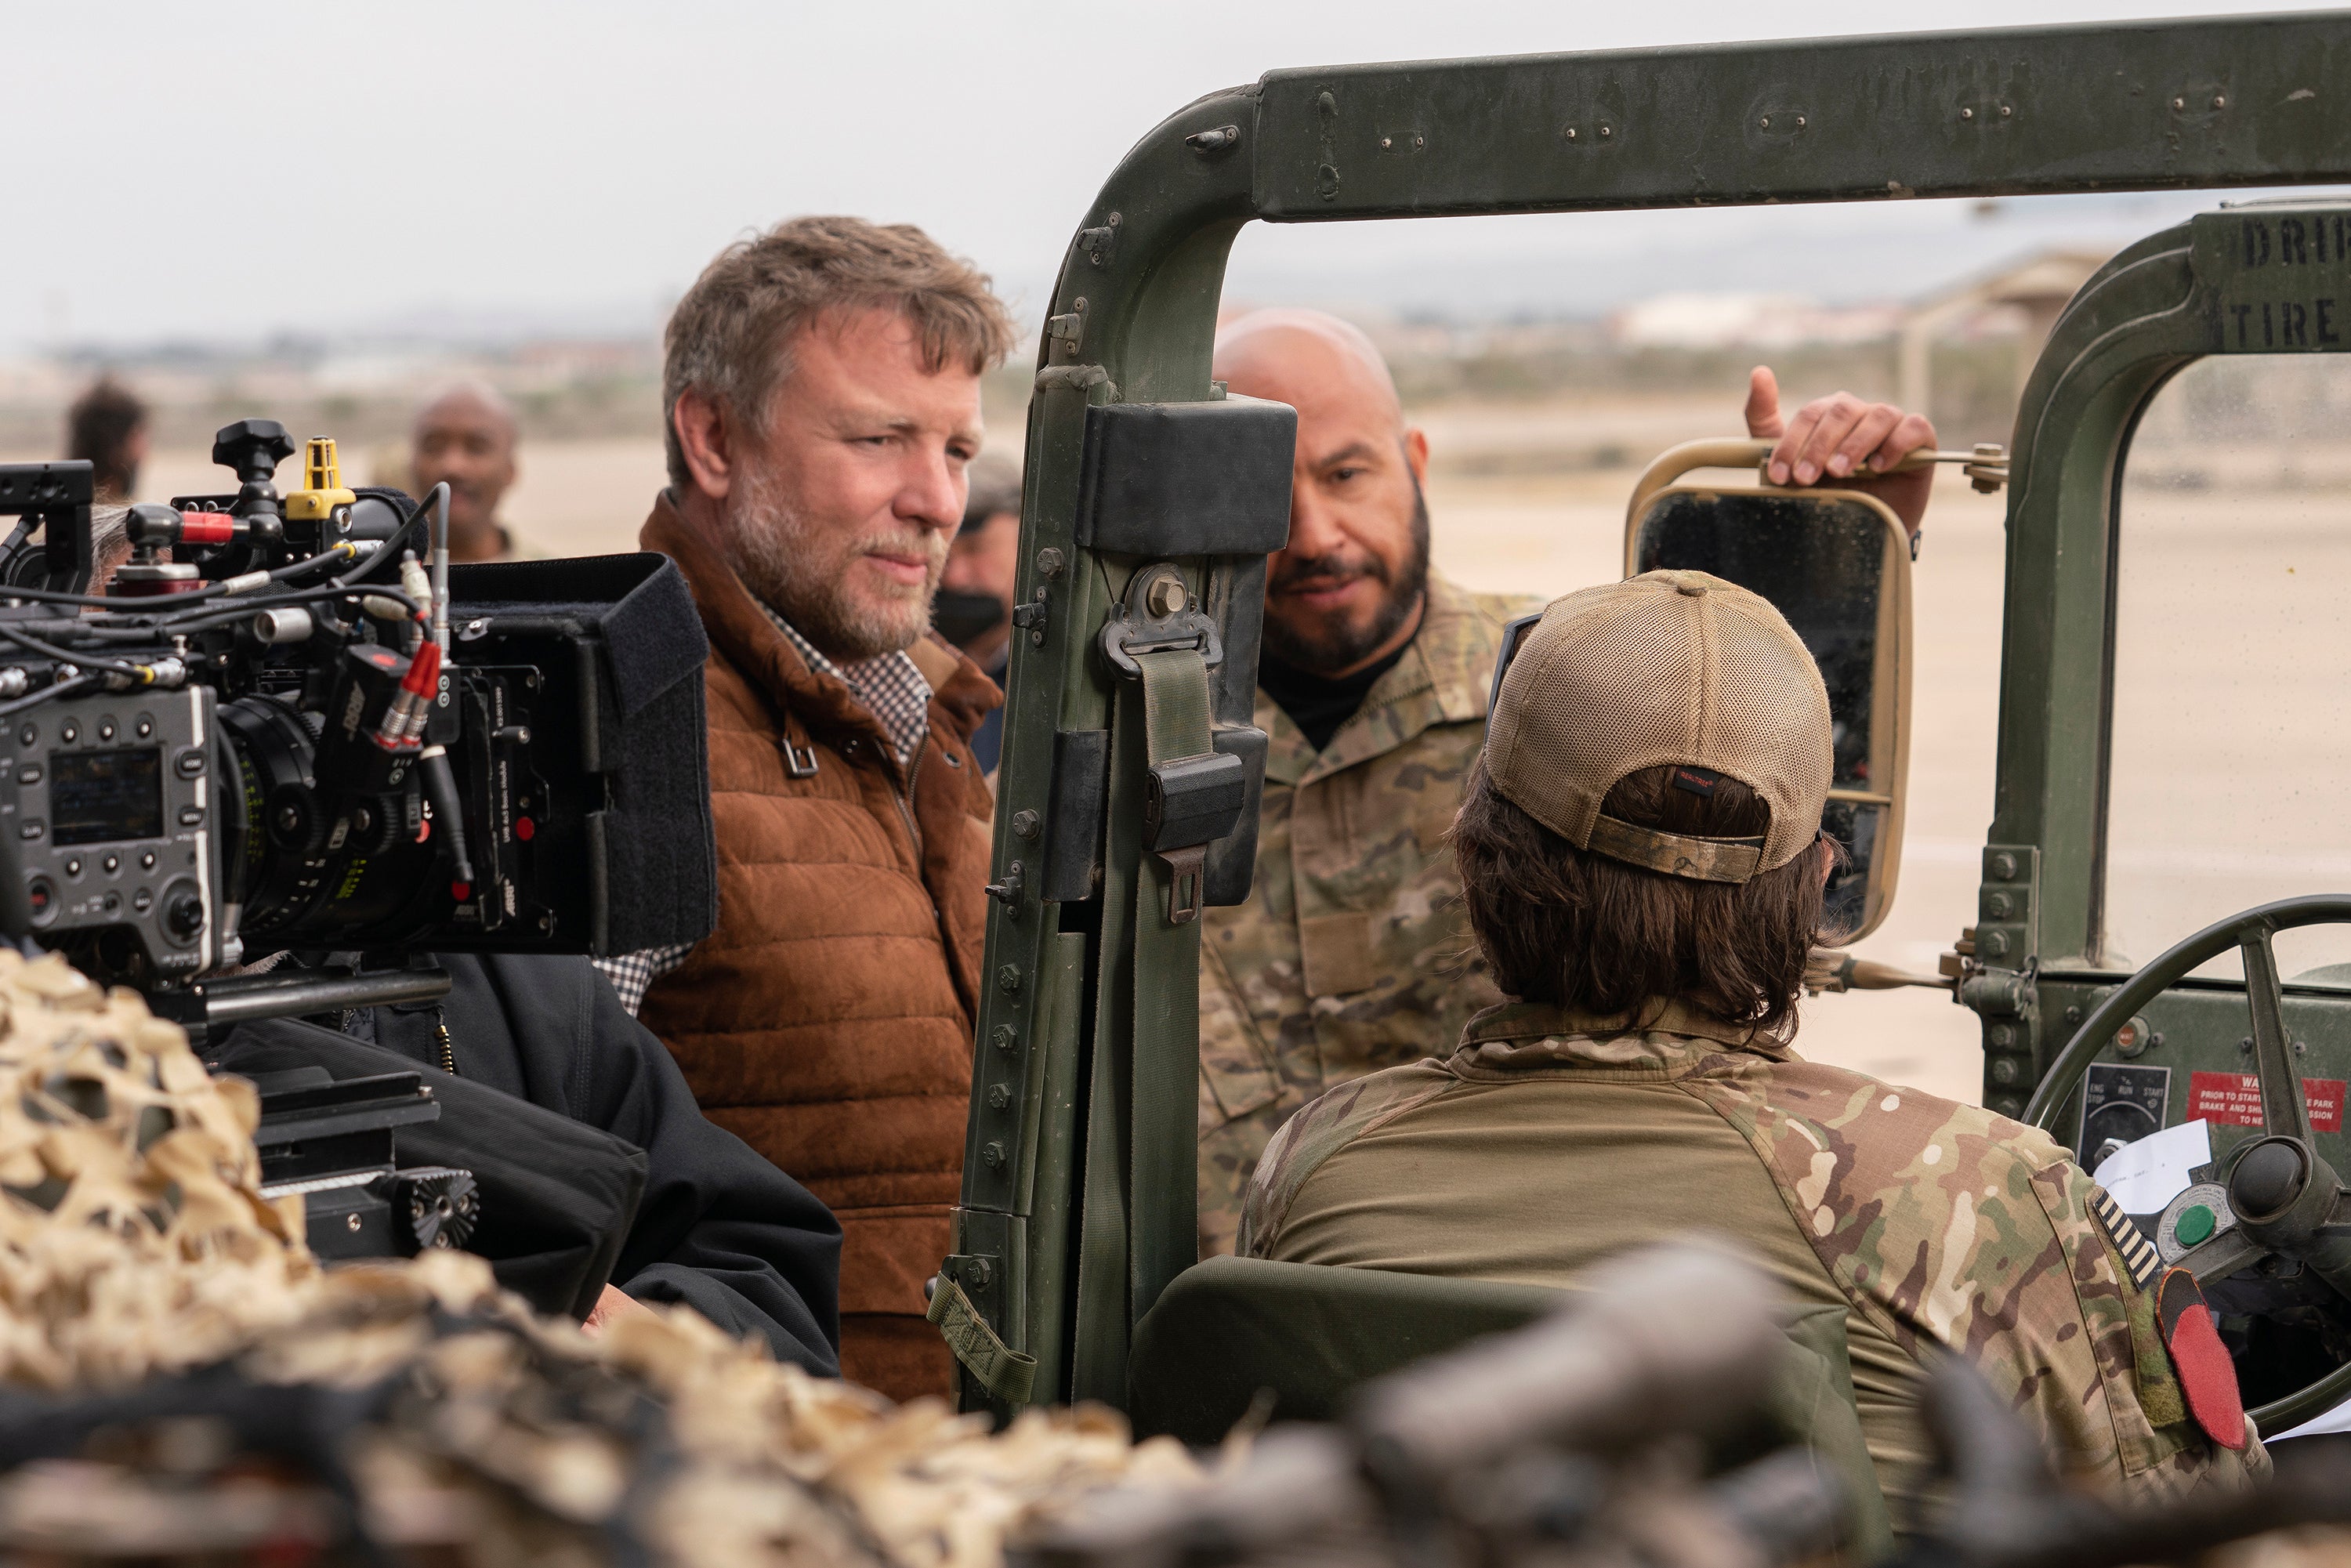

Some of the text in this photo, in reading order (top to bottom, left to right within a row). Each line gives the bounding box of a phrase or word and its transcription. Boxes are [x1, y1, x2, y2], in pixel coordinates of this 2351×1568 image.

[2231, 299, 2339, 347] TIRE
[504, 885, 516, 918] ARRI
[2089, 1083, 2105, 1094] ENG
[2117, 1085, 2133, 1095] RUN
[2143, 1087, 2164, 1097] START
[2088, 1094, 2105, 1104] STOP
[2201, 1090, 2225, 1100] PRIOR
[2226, 1092, 2237, 1101] TO
[2313, 1099, 2334, 1109] PARK
[2199, 1101, 2226, 1112] BRAKE
[2229, 1103, 2247, 1114] AND
[2240, 1115, 2251, 1124] TO
